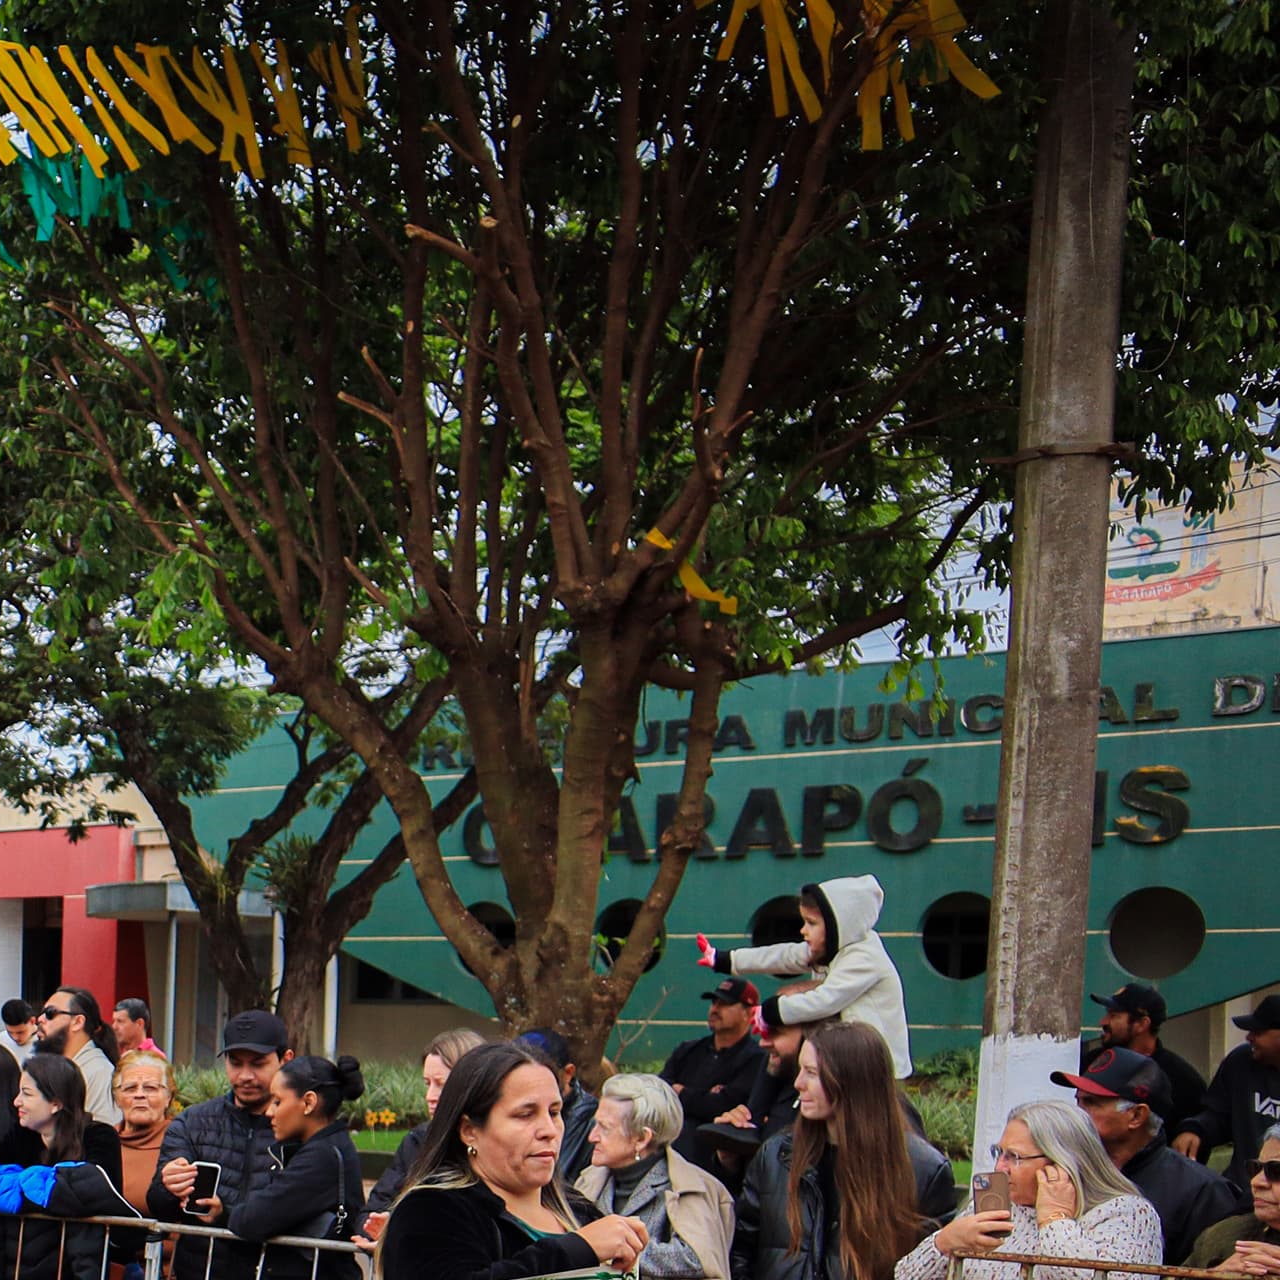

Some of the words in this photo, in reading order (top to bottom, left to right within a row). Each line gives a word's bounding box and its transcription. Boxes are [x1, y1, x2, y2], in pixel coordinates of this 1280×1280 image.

[784, 682, 1180, 747] MUNICAL
[1212, 672, 1280, 717] D
[462, 757, 944, 868] CARAPÓ
